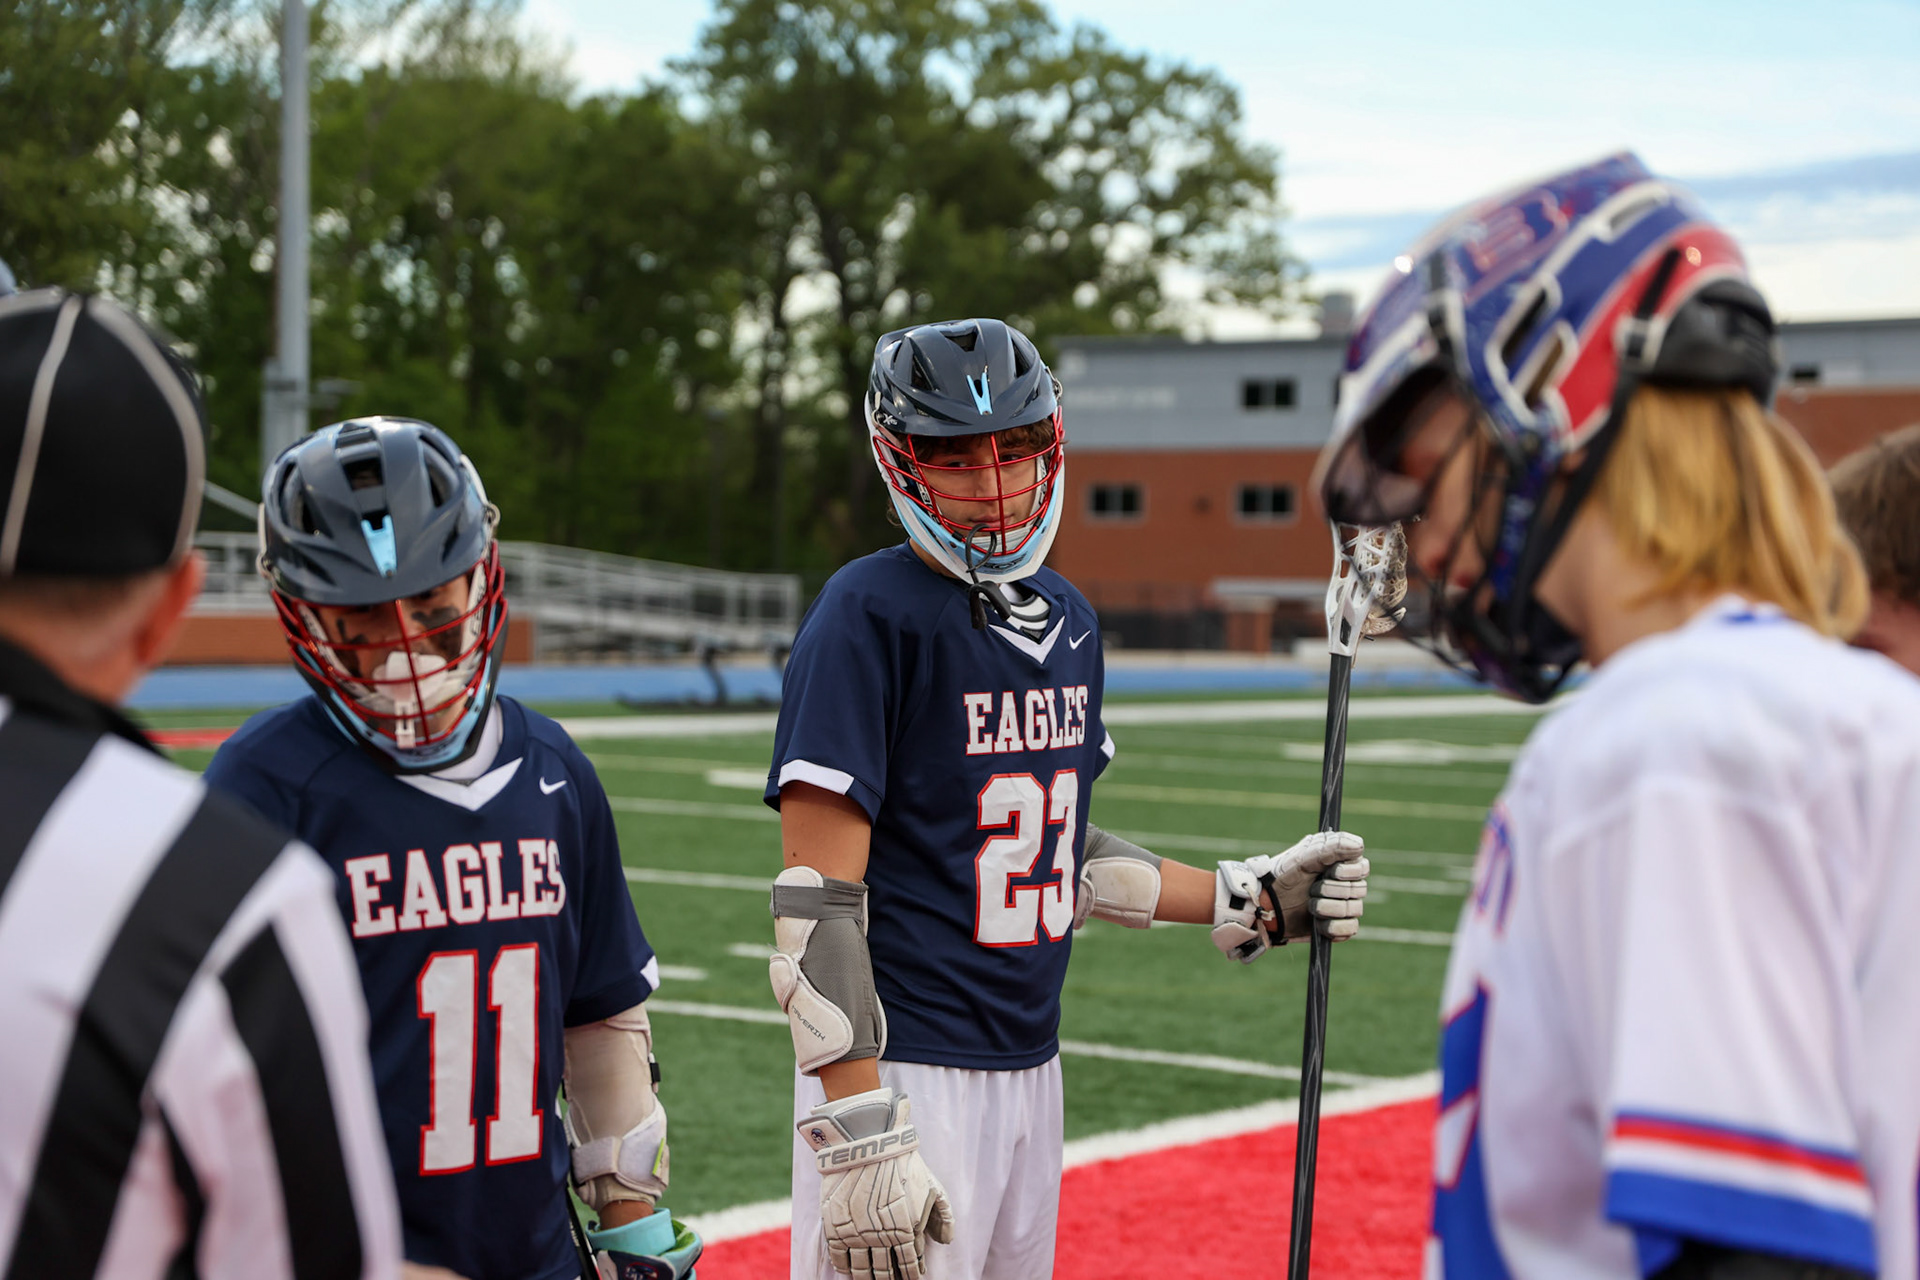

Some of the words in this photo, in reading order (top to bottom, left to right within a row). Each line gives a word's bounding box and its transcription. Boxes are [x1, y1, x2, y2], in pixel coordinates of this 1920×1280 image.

[963, 685, 1088, 755] EAGLES
[345, 839, 566, 938] EAGLES
[972, 768, 1078, 948] 23
[416, 942, 543, 1176] 11
[791, 1004, 826, 1041] MAVERIK
